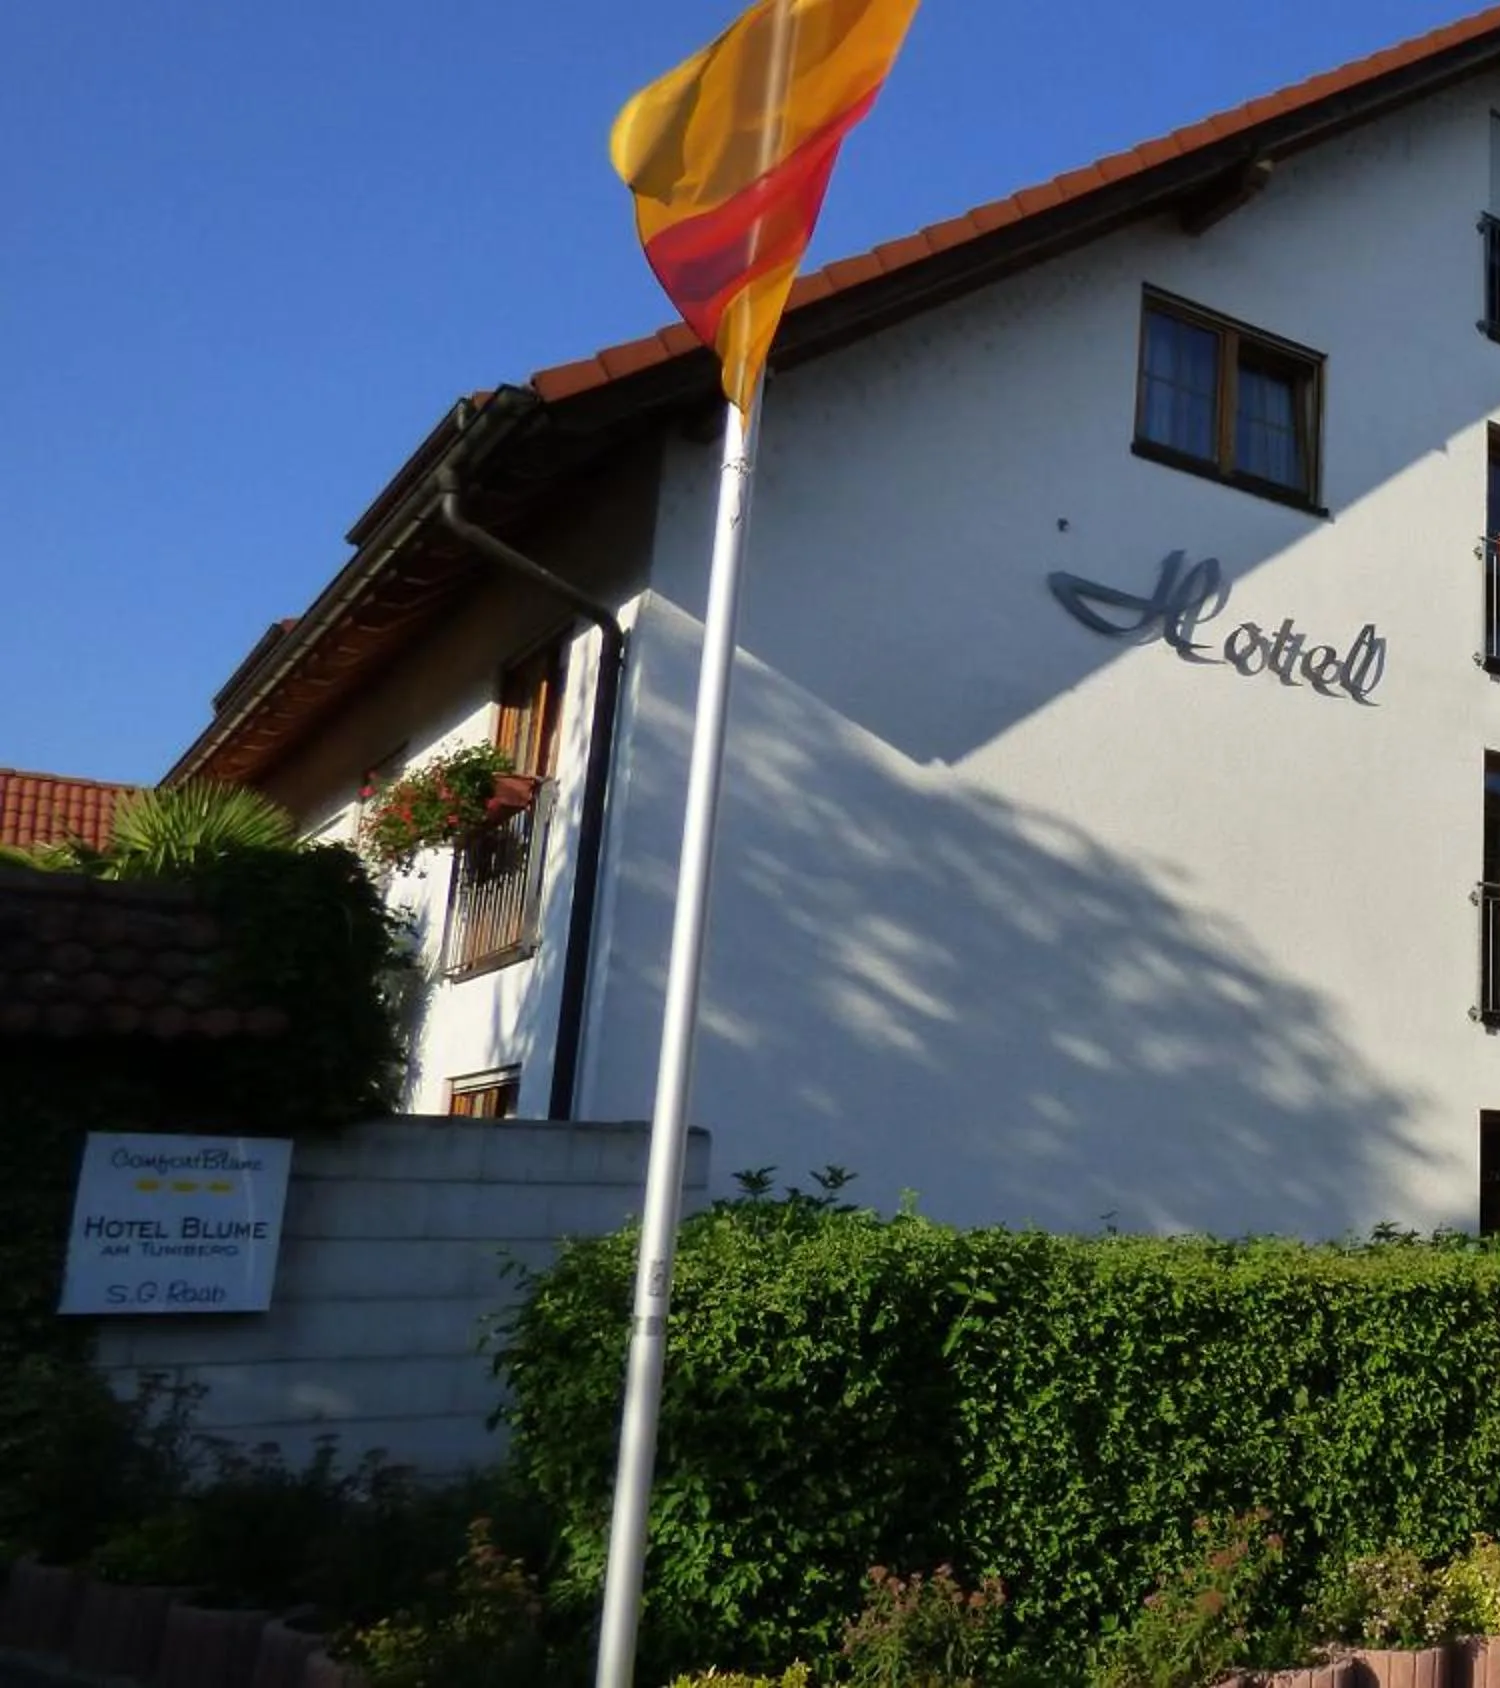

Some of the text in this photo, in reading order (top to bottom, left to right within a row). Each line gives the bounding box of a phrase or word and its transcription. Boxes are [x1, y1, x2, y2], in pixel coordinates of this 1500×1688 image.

[1046, 549, 1383, 701] Hotel
[84, 1216, 269, 1240] HOTEL BLUME
